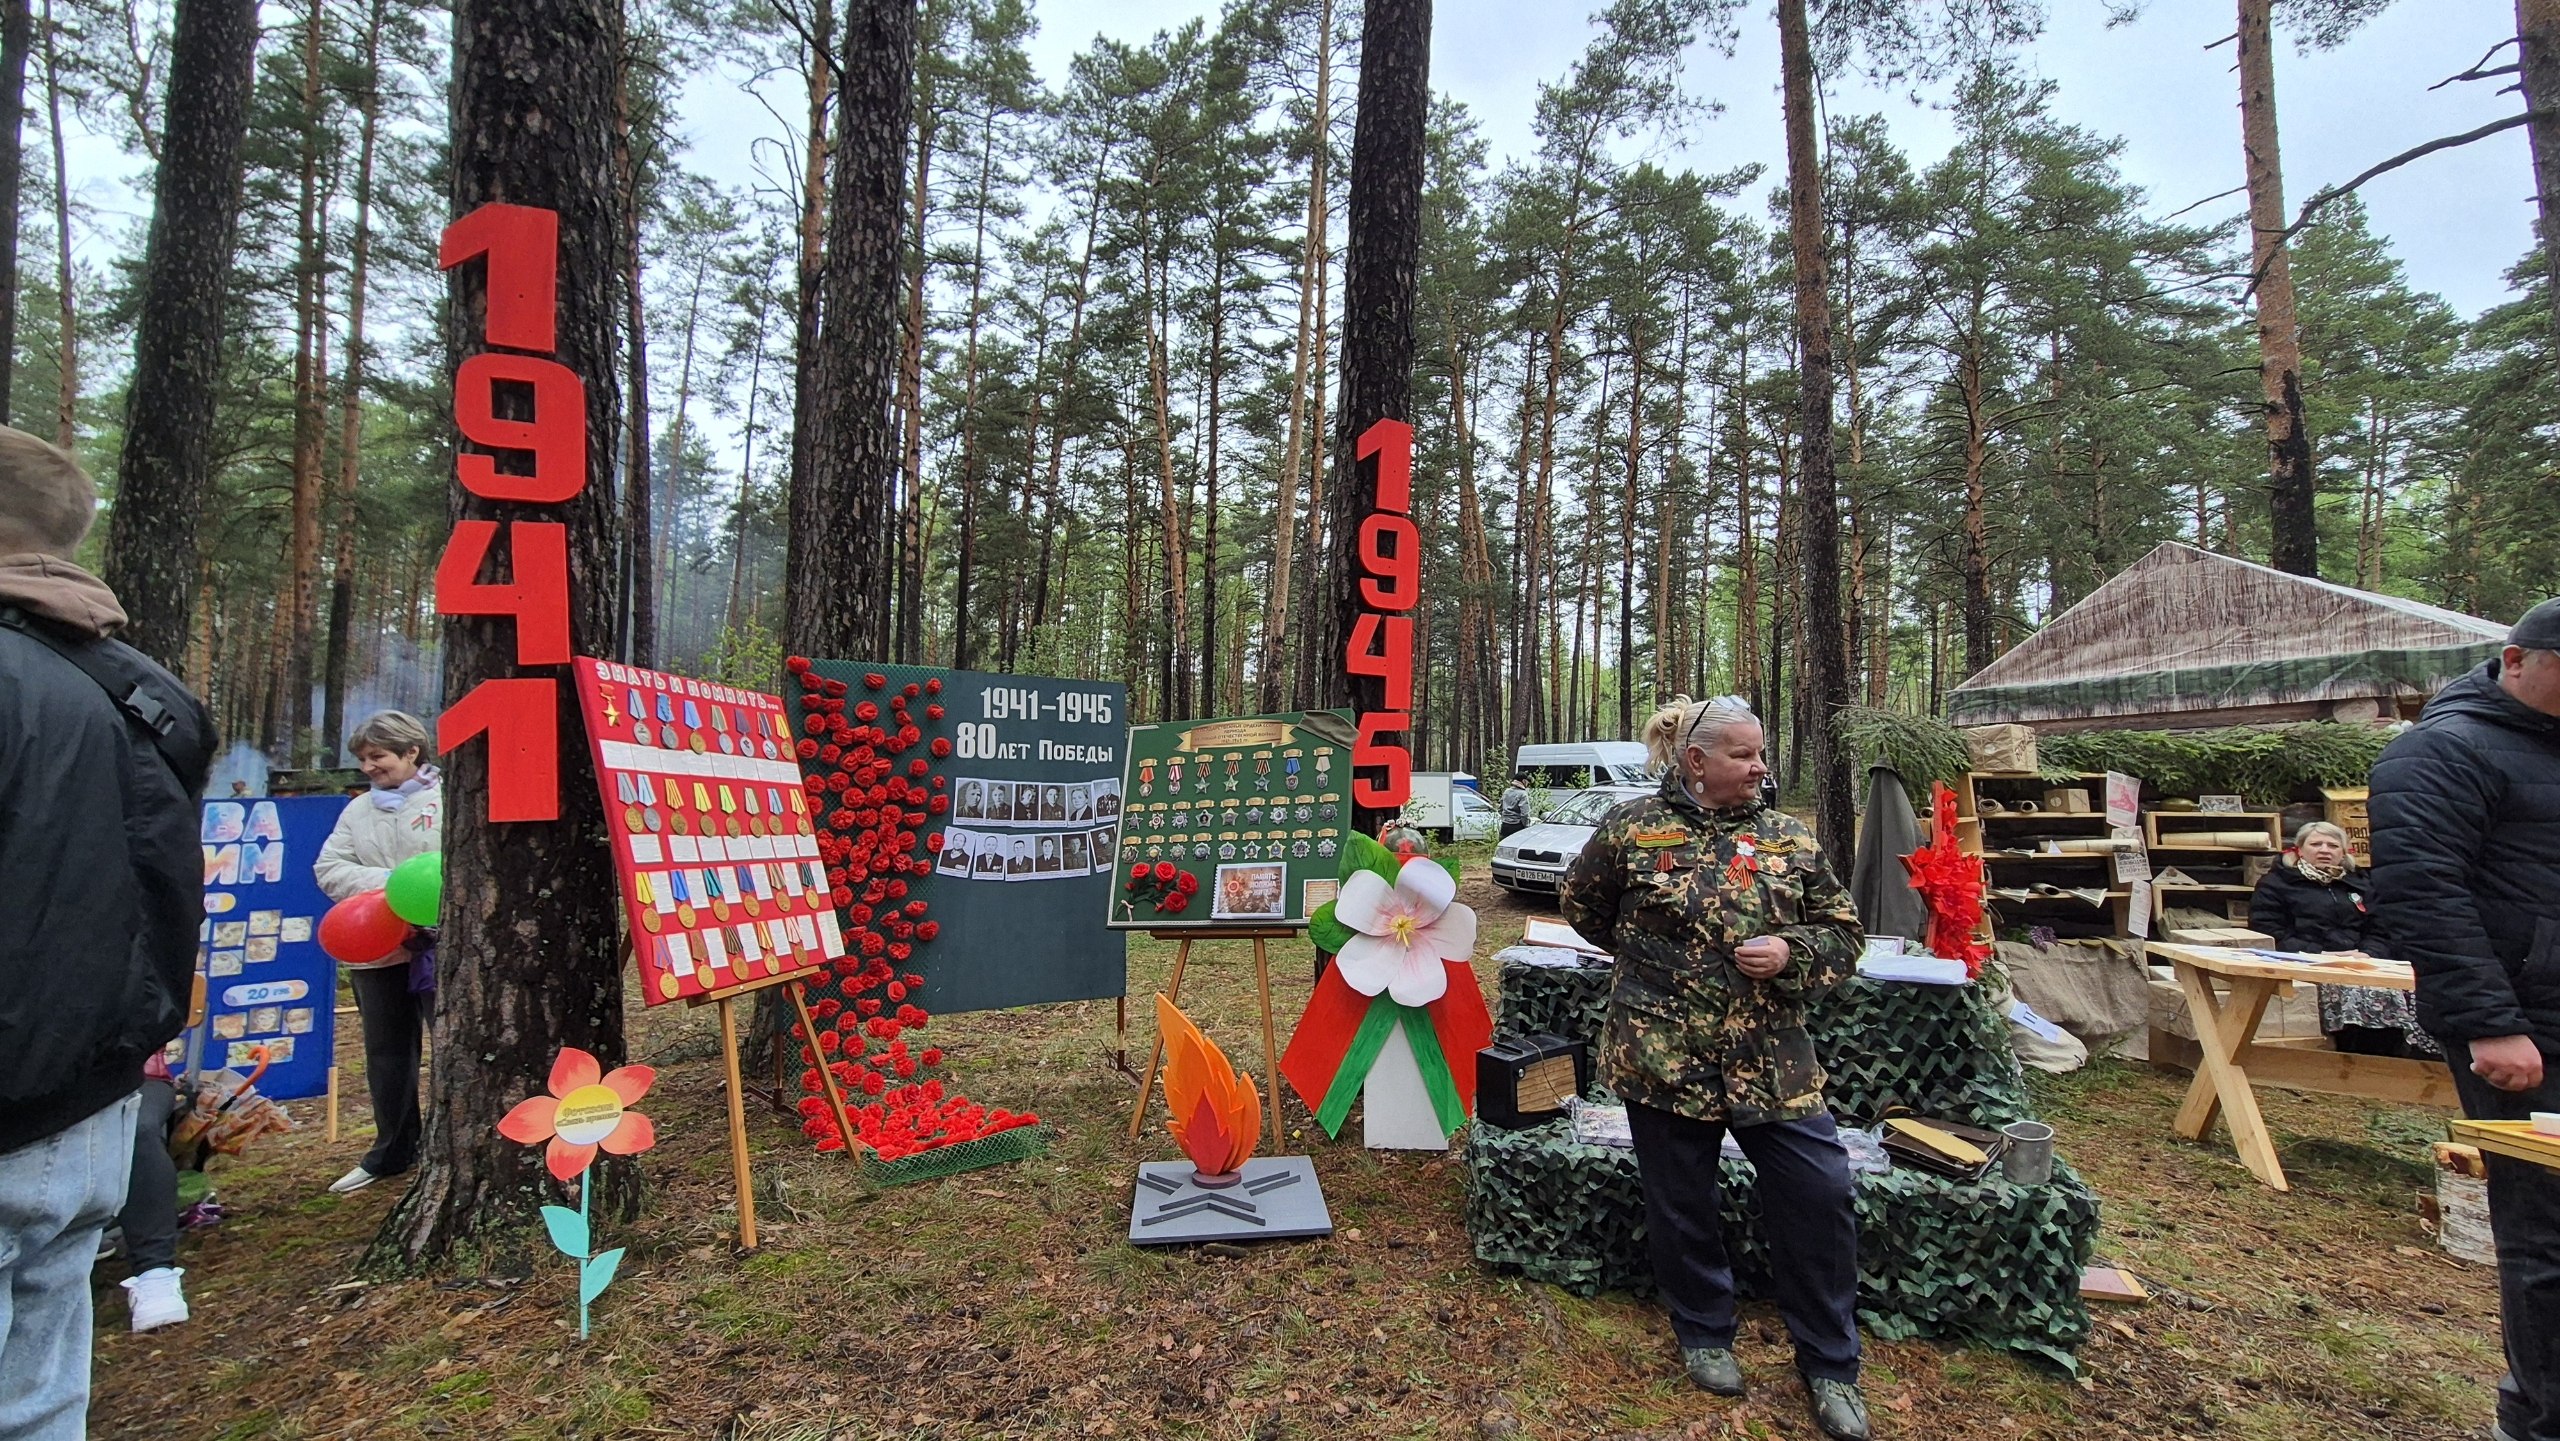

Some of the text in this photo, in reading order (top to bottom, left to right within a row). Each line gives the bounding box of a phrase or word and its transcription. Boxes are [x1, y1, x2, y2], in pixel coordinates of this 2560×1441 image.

[434, 202, 587, 823] 1941
[1346, 417, 1421, 809] 1945
[595, 661, 667, 690] ЗНАТЬ
[668, 677, 685, 694] И
[956, 722, 997, 760] 80
[201, 801, 283, 843] ВА
[203, 842, 284, 885] ИМ
[247, 987, 269, 1000] 20
